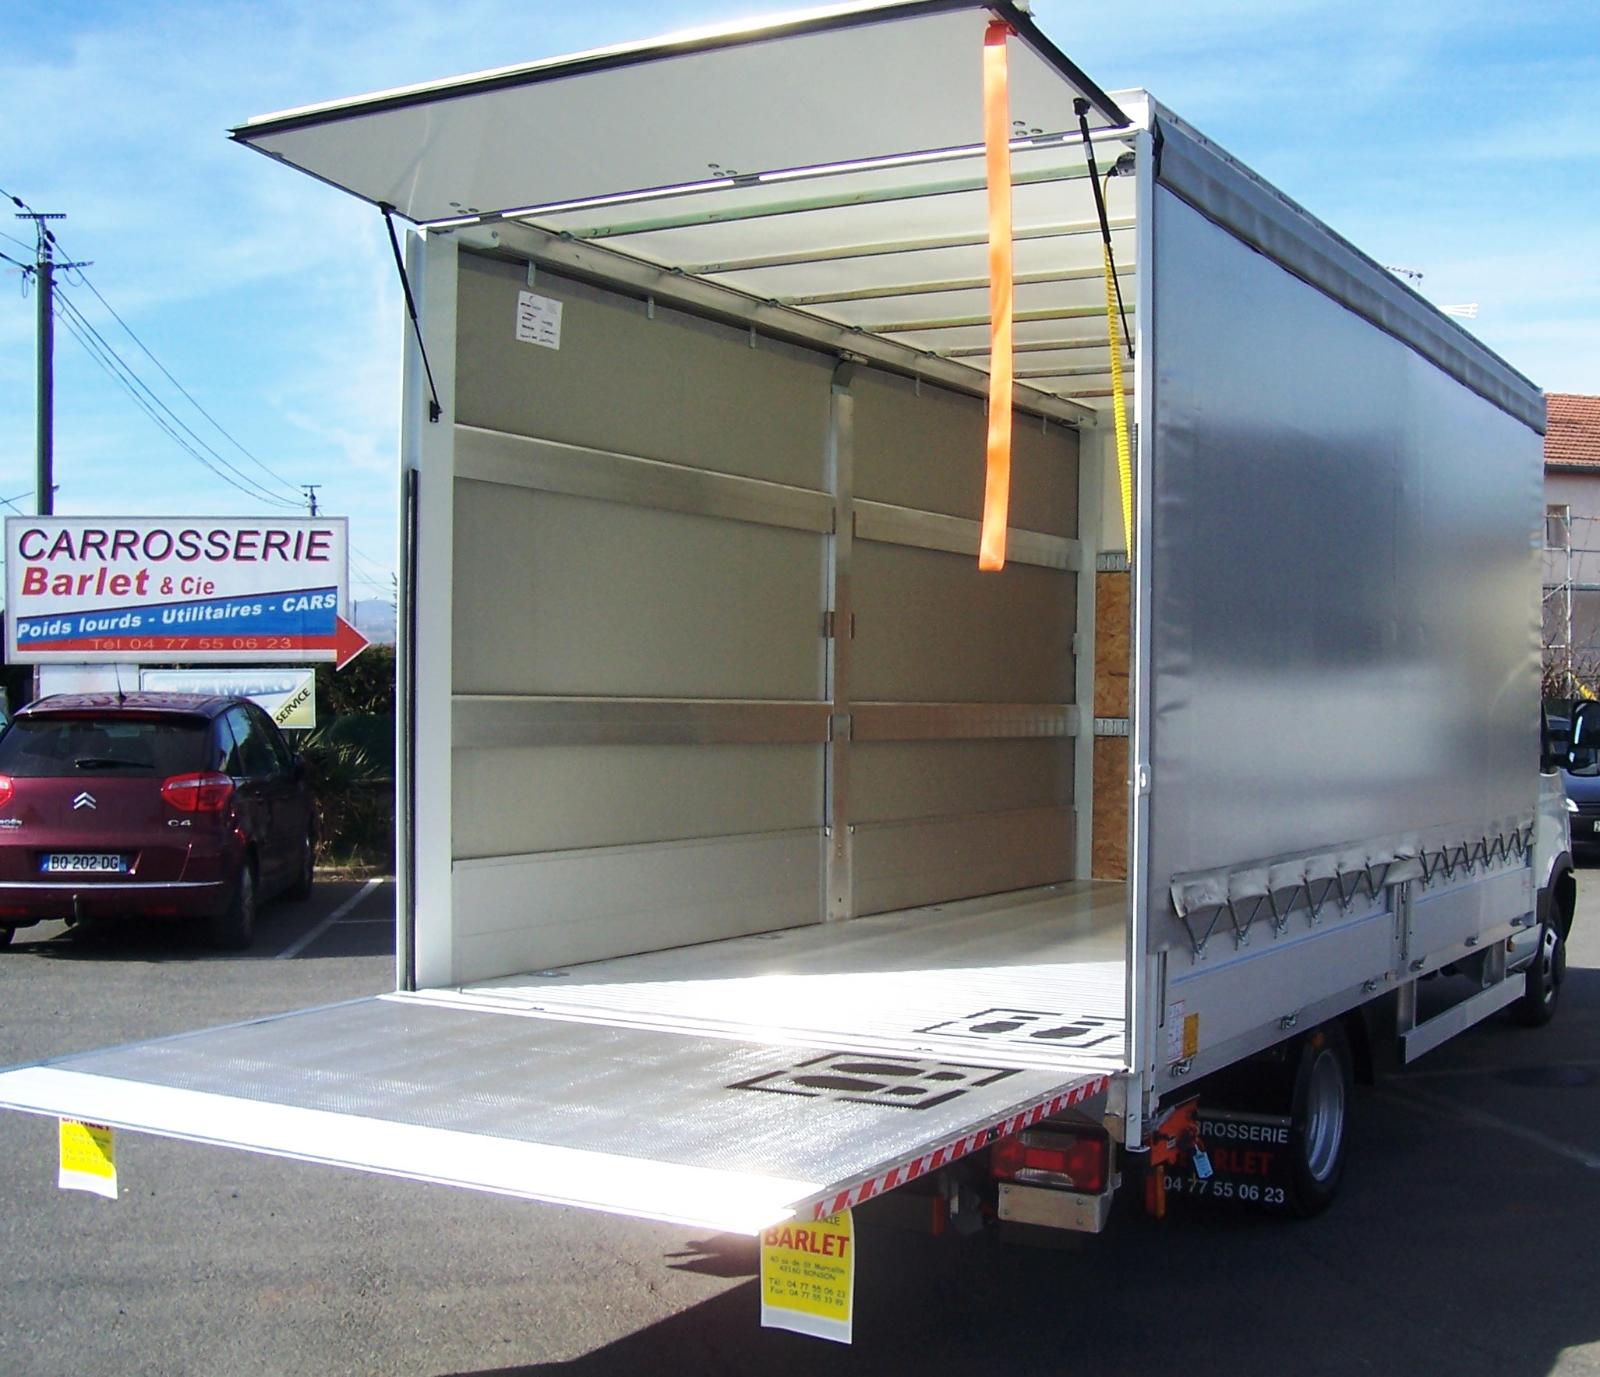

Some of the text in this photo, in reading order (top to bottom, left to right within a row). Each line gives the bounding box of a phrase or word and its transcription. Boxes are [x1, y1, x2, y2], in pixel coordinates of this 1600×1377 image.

[18, 528, 334, 562] CARROSSERIE
[21, 566, 215, 596] Barlet & Cie
[17, 618, 72, 639] Poids
[78, 613, 142, 632] lourds
[162, 601, 262, 625] Utilitaires
[282, 594, 337, 612] CARS
[130, 639, 154, 649] 04
[164, 639, 187, 649] 77
[200, 639, 224, 649] 55
[232, 639, 257, 649] 06
[267, 638, 292, 649] 23
[275, 687, 312, 724] SERVICE
[167, 819, 191, 827] C4
[1187, 1178, 1208, 1195] 77
[1213, 1181, 1234, 1198] 55
[1239, 1184, 1260, 1201] 06
[1264, 1187, 1285, 1204] 23
[764, 1226, 850, 1258] BARLET
